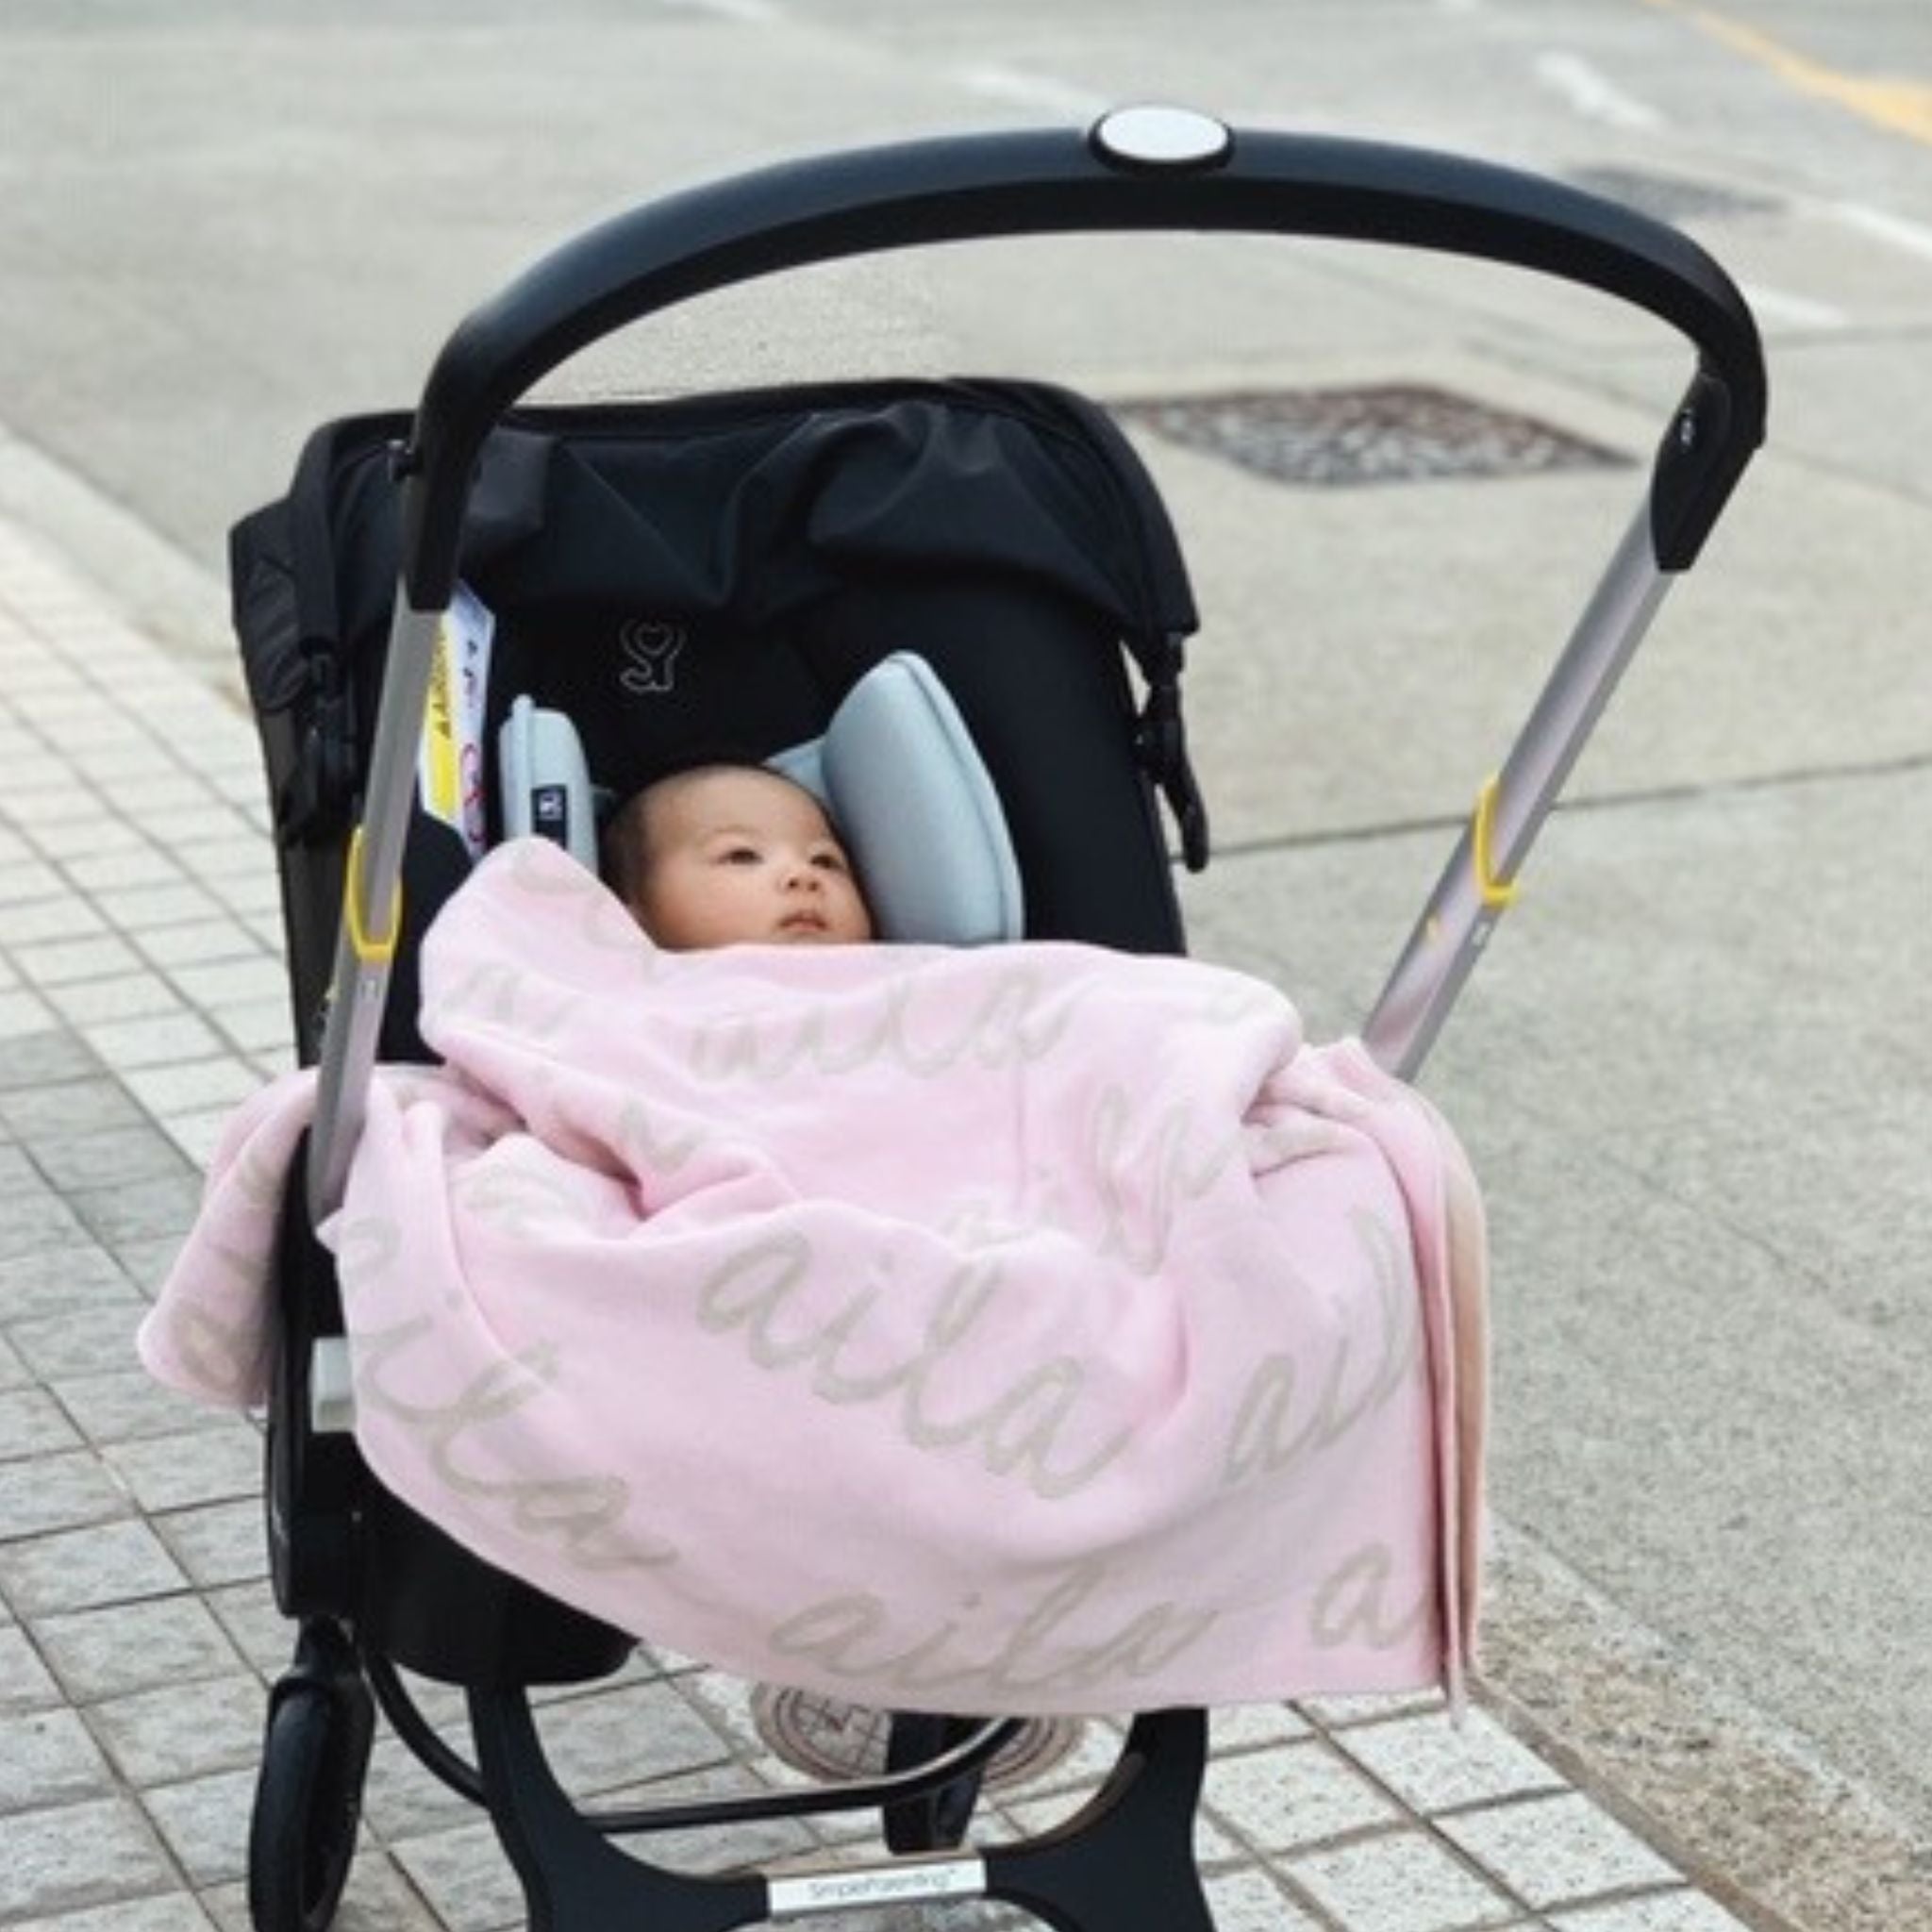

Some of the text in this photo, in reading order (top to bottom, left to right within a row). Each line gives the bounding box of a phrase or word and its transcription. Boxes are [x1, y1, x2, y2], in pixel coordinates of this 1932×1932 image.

[696, 1203, 1417, 1502] aila ail
[767, 1557, 1219, 1690] aila
